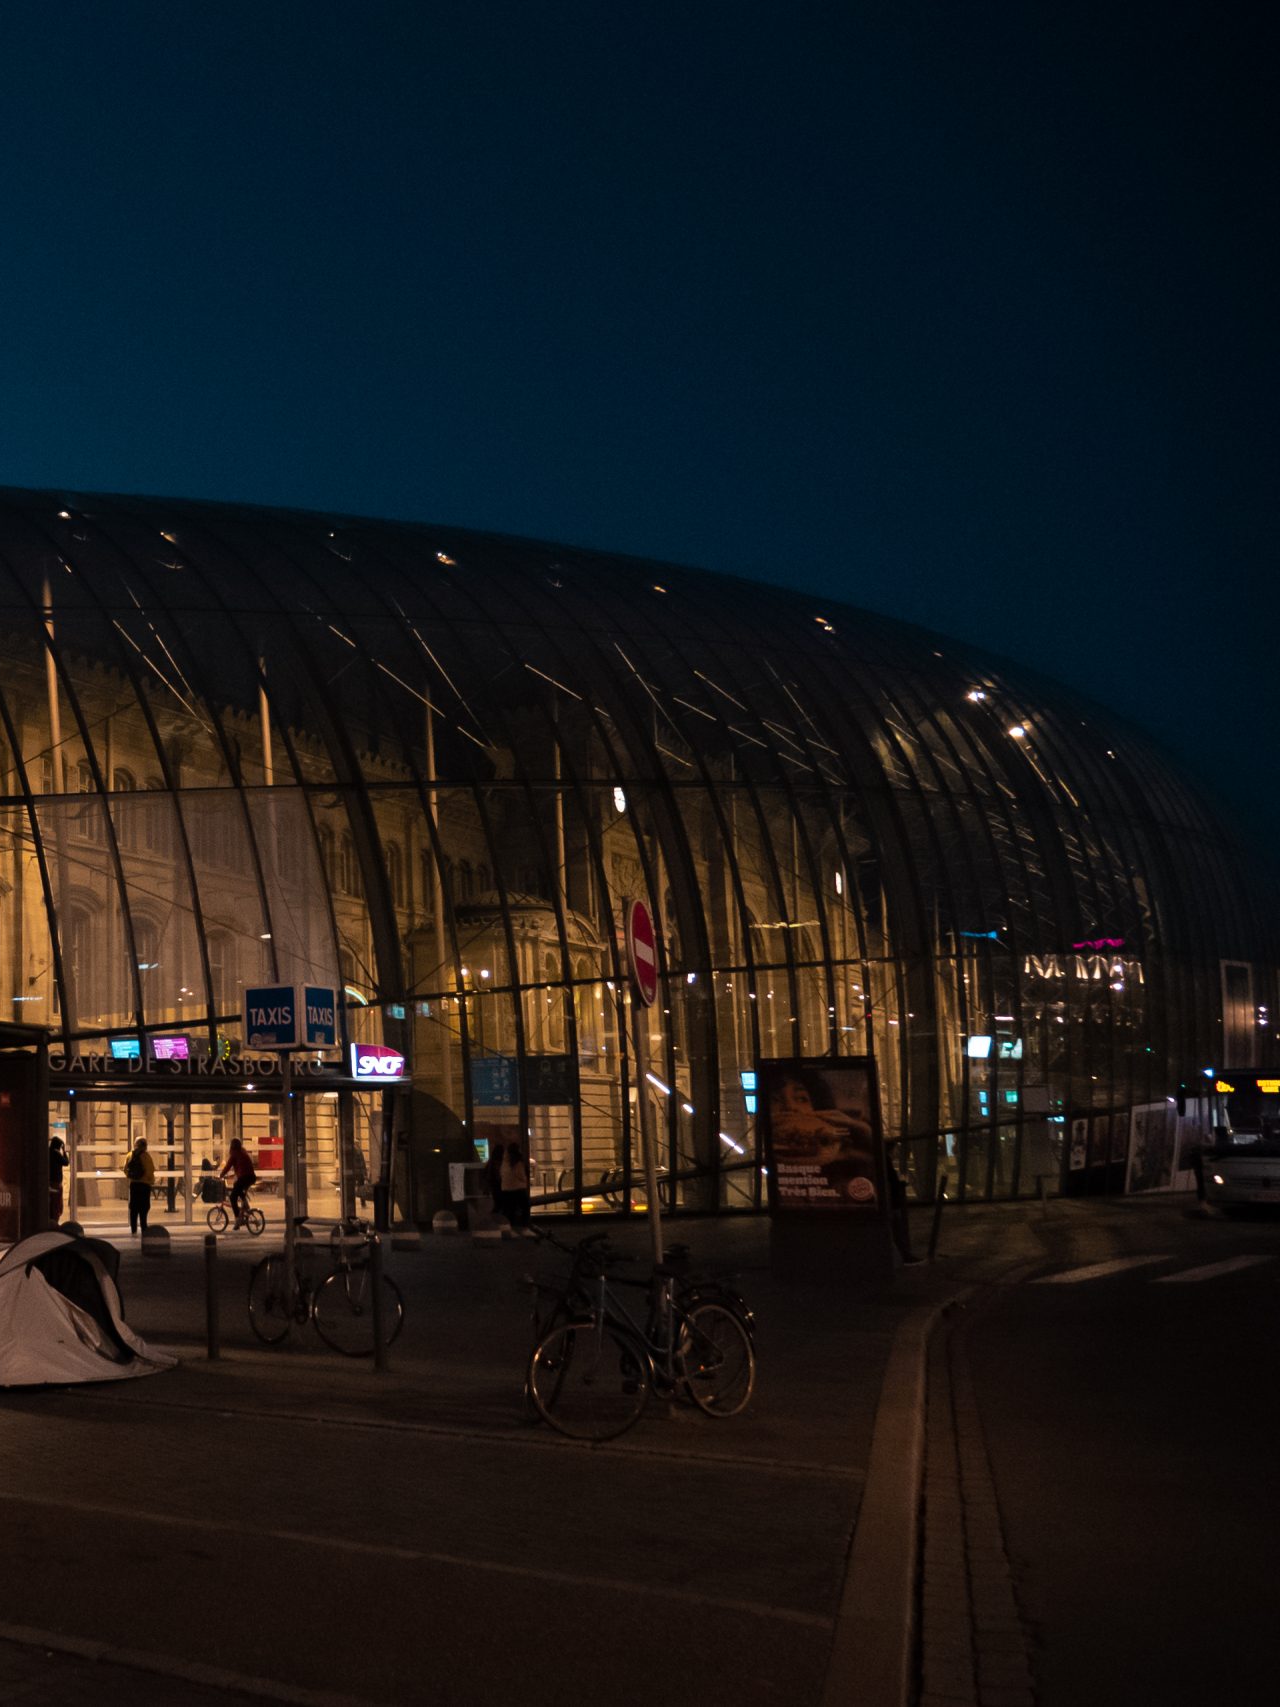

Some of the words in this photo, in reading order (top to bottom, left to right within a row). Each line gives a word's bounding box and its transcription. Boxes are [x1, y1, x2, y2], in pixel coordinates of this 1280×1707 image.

[249, 1006, 292, 1027] TAXIS
[307, 1006, 334, 1027] TAXIS
[48, 1050, 115, 1073] GARE
[128, 1052, 158, 1074] DE
[357, 1055, 405, 1075] SNCF
[777, 1174, 829, 1186] mention
